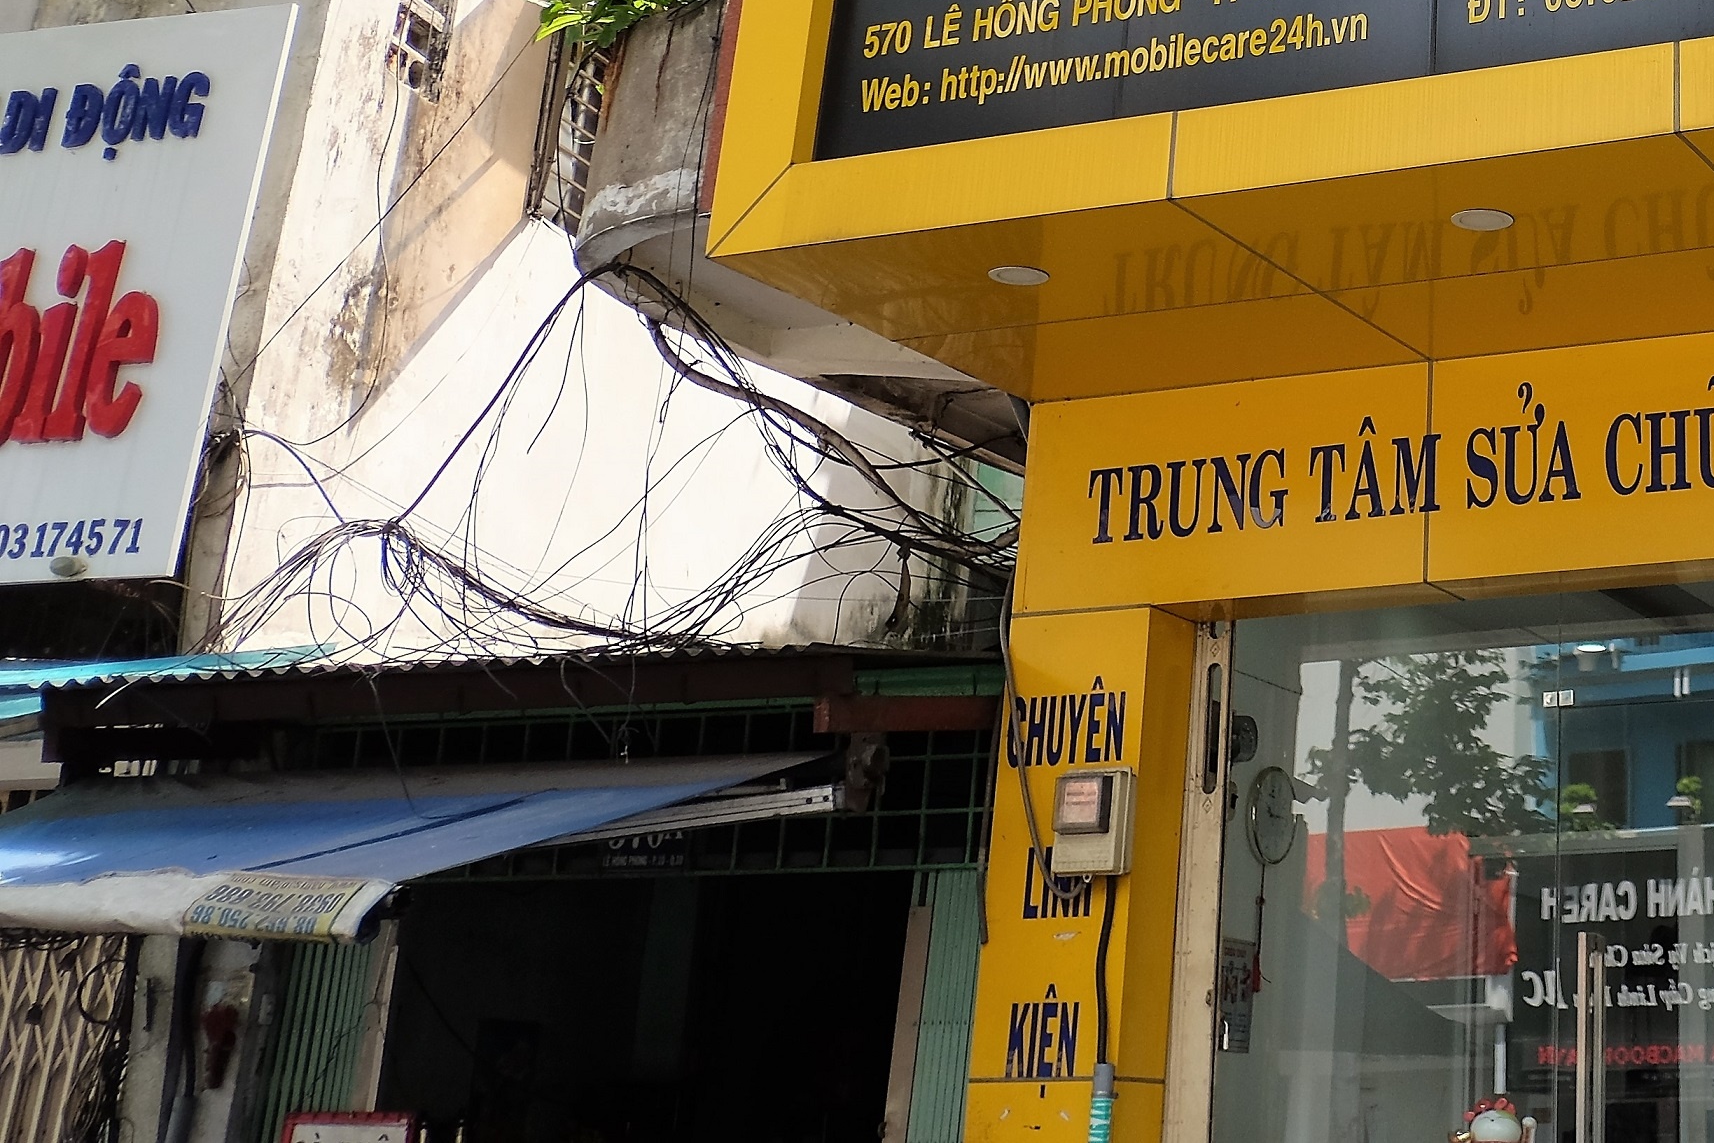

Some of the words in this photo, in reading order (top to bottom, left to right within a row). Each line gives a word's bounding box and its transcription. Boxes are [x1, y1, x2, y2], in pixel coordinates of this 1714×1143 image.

[861, 75, 930, 113] Web:
[940, 10, 1369, 104] http://www.mobilecare24h.vn
[862, 20, 912, 59] 570
[923, 4, 962, 49] LÊ
[0, 86, 58, 155] DI
[61, 63, 211, 161] ĐỘNG
[1088, 448, 1290, 545] TRUNG
[1310, 416, 1441, 525] TÂM
[1465, 381, 1581, 510] SỬA
[1006, 675, 1127, 768] CHUYÊN
